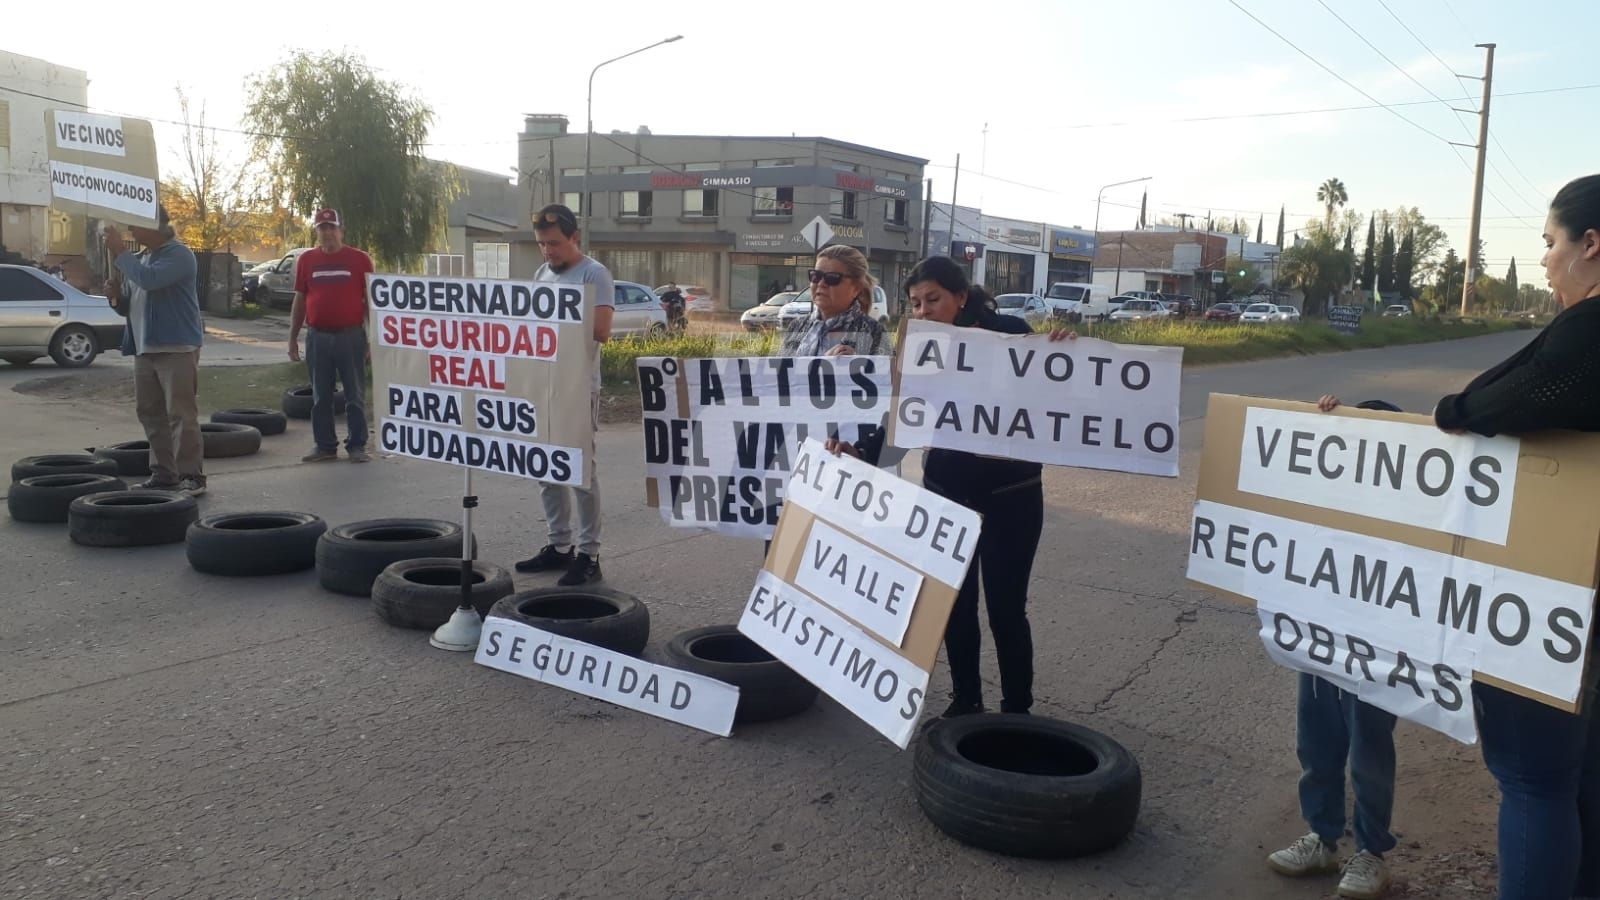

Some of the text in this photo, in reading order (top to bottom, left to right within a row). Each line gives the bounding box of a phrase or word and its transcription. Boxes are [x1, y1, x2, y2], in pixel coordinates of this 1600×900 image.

[52, 169, 153, 203] AUTOCONVOCADOS
[703, 176, 751, 186] GIMNASIO
[371, 278, 582, 321] GOBERNADOR
[383, 315, 557, 358] SEGURIDAD
[430, 354, 506, 390] REAL
[700, 358, 879, 410] ALTOS
[917, 339, 1151, 391] AL VOTO
[389, 387, 536, 434] PARA SUS
[899, 397, 1174, 453] GANATELO
[382, 422, 571, 482] CIUDADANOS
[644, 418, 709, 467] DEL
[1256, 426, 1502, 507] VECINOS
[670, 475, 784, 525] PRESE
[790, 452, 968, 564] ALTOS DEL
[814, 539, 905, 616] VALLE
[485, 631, 692, 710] SEGURIDAD
[750, 586, 923, 720] EXISTIMOS
[1273, 612, 1463, 711] OBRAS
